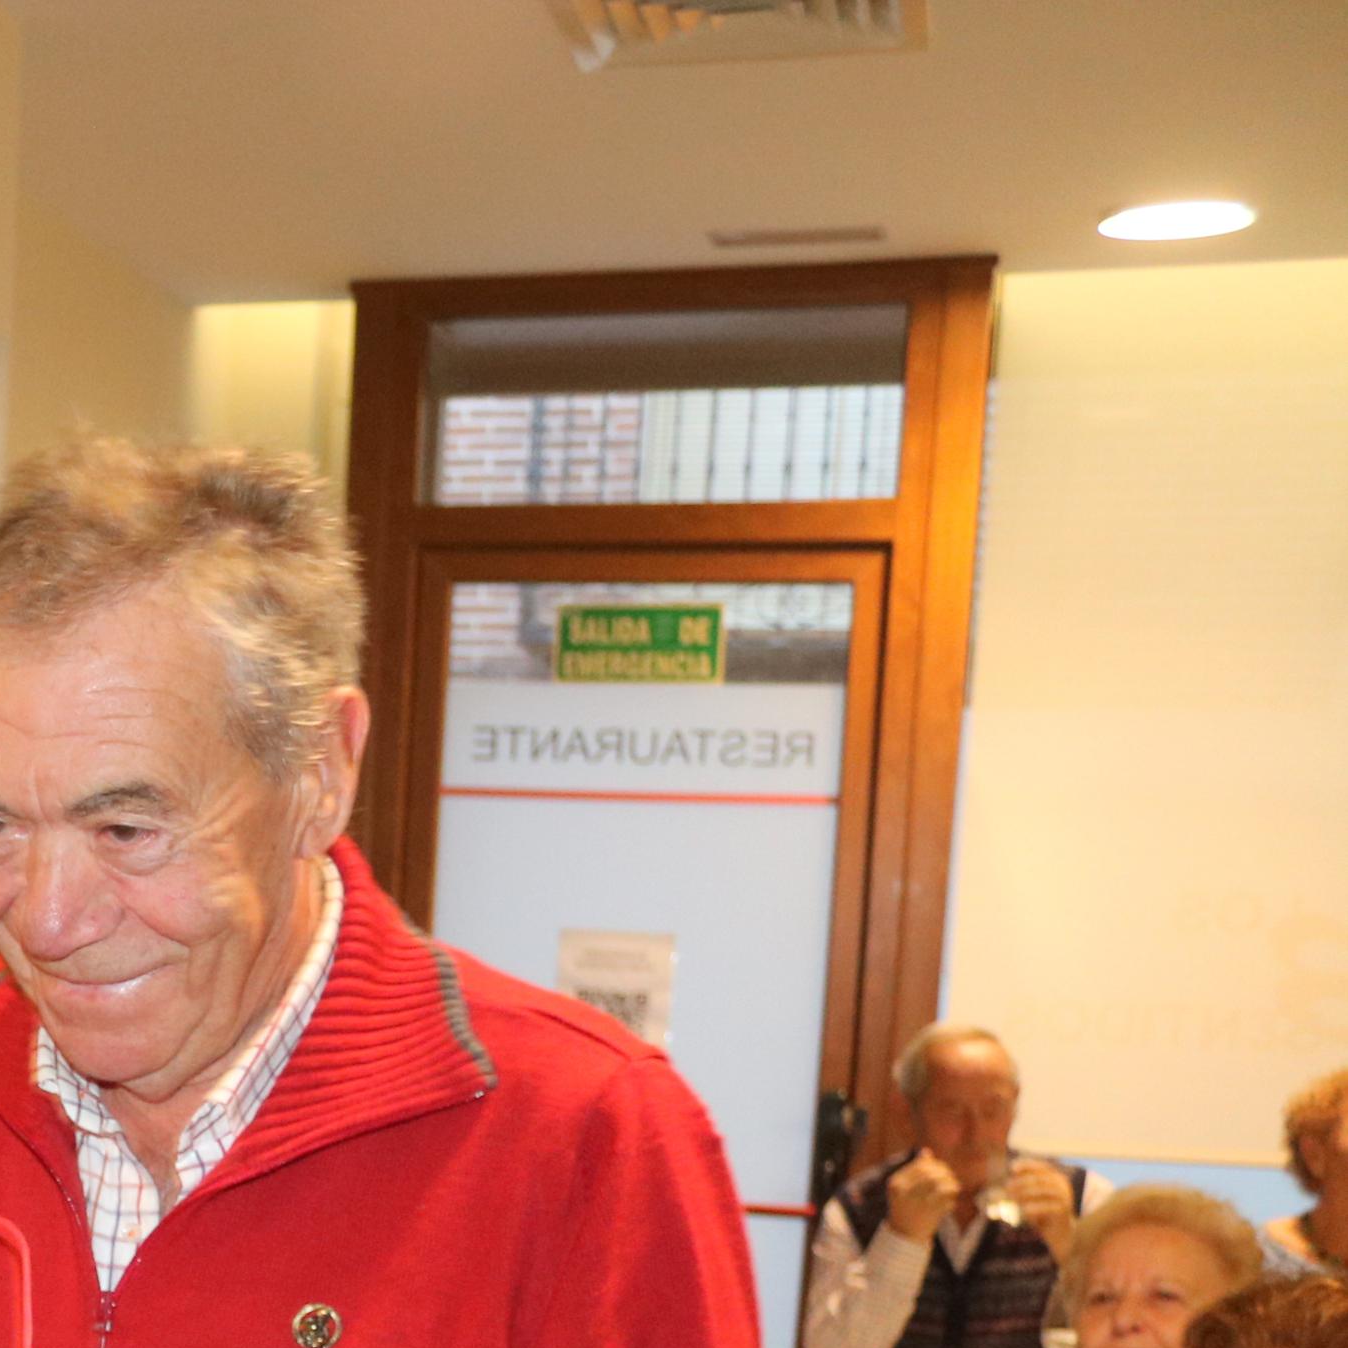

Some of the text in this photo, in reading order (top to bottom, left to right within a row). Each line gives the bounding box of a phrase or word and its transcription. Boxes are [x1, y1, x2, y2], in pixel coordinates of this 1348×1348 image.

[569, 616, 710, 645] SALIDA DE
[564, 651, 711, 677] EMERGENCIA
